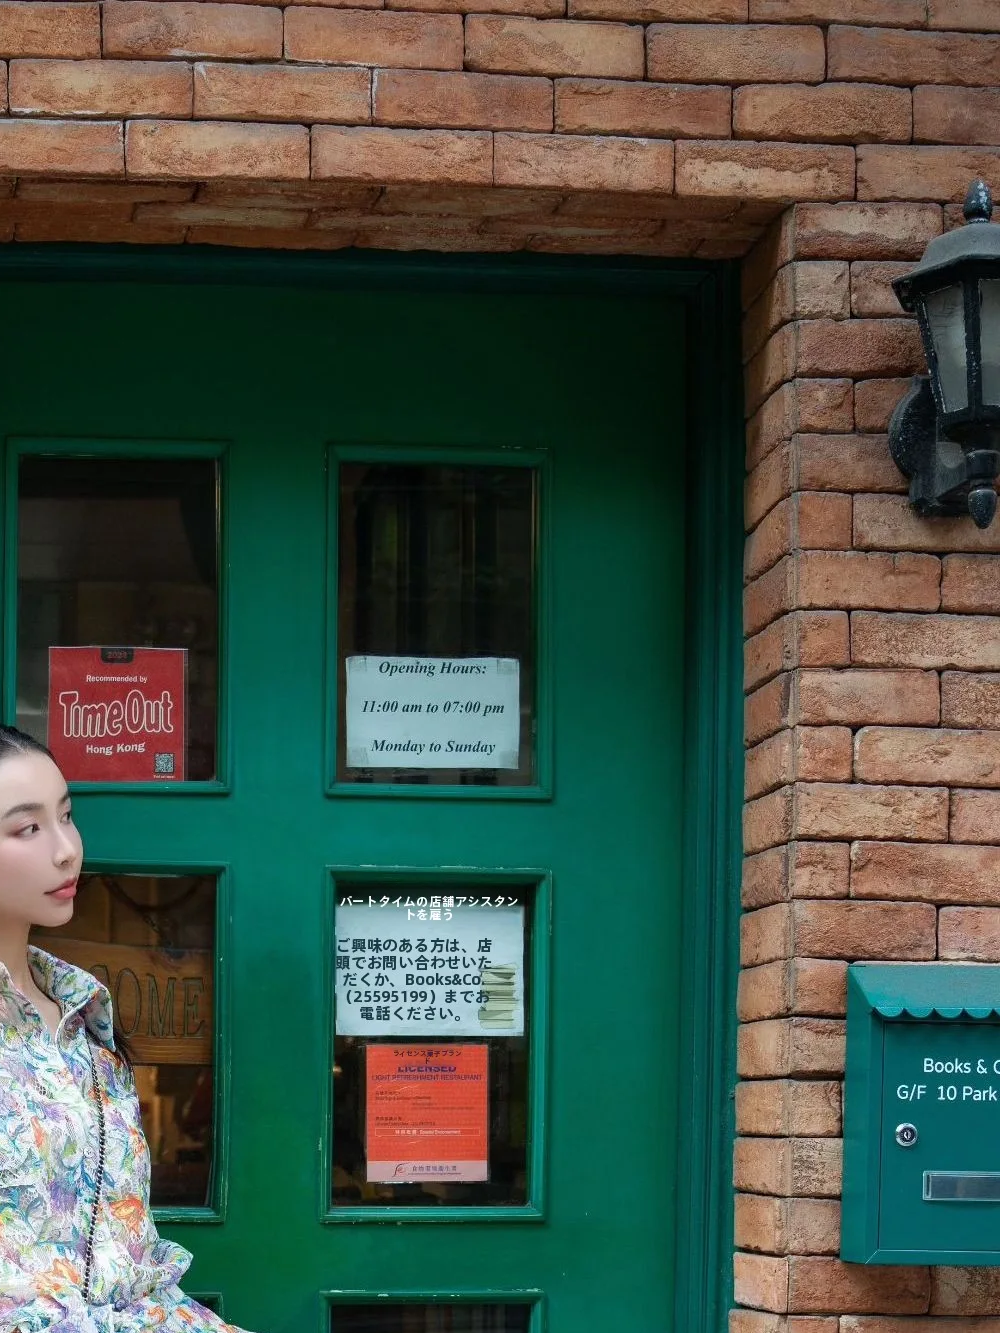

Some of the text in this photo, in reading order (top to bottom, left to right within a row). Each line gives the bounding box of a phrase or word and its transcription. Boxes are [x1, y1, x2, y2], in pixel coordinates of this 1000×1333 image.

[378, 661, 487, 677] Opening Hours:
[86, 675, 148, 684] Recommended by
[361, 700, 504, 717] 11:00 am to 07:00 pm
[86, 741, 146, 756] Hong Kong
[371, 739, 496, 756] Monday to Sunday
[89, 964, 205, 1038] OME
[923, 1057, 972, 1074] Books
[976, 1058, 988, 1074] &
[896, 1084, 998, 1101] G/F 10 Park
